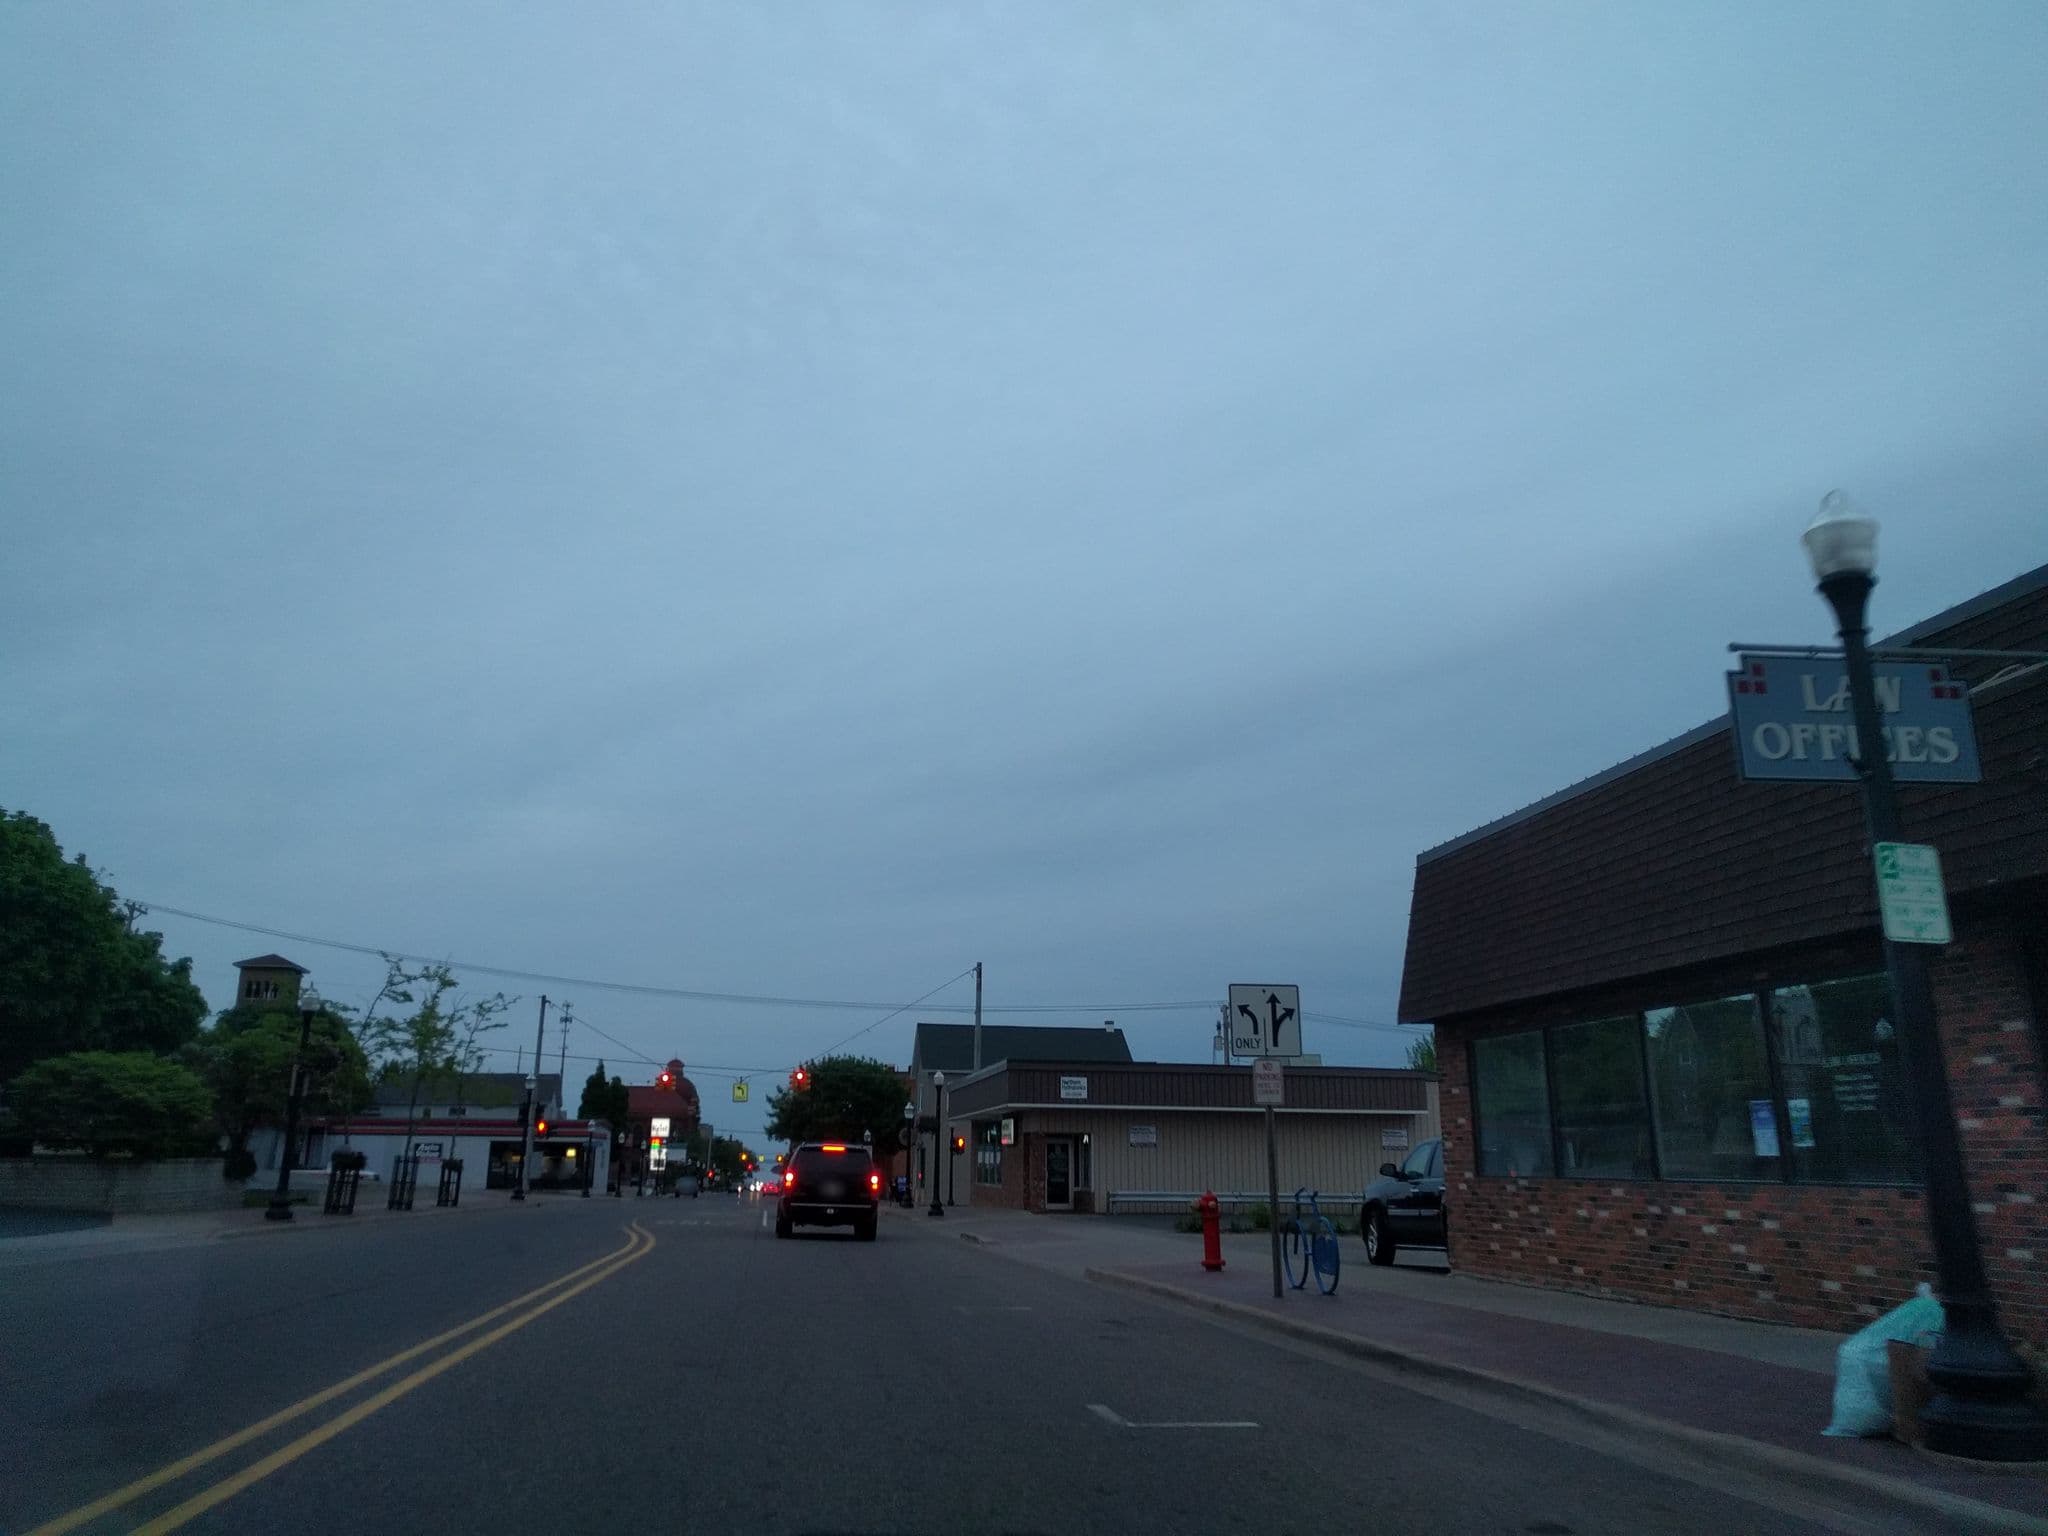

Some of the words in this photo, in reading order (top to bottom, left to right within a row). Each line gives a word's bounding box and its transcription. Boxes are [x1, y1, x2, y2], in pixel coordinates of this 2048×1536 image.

[1752, 721, 1960, 764] OFFIES
[1235, 1037, 1261, 1049] ONLY
[1262, 1063, 1273, 1071] NO
